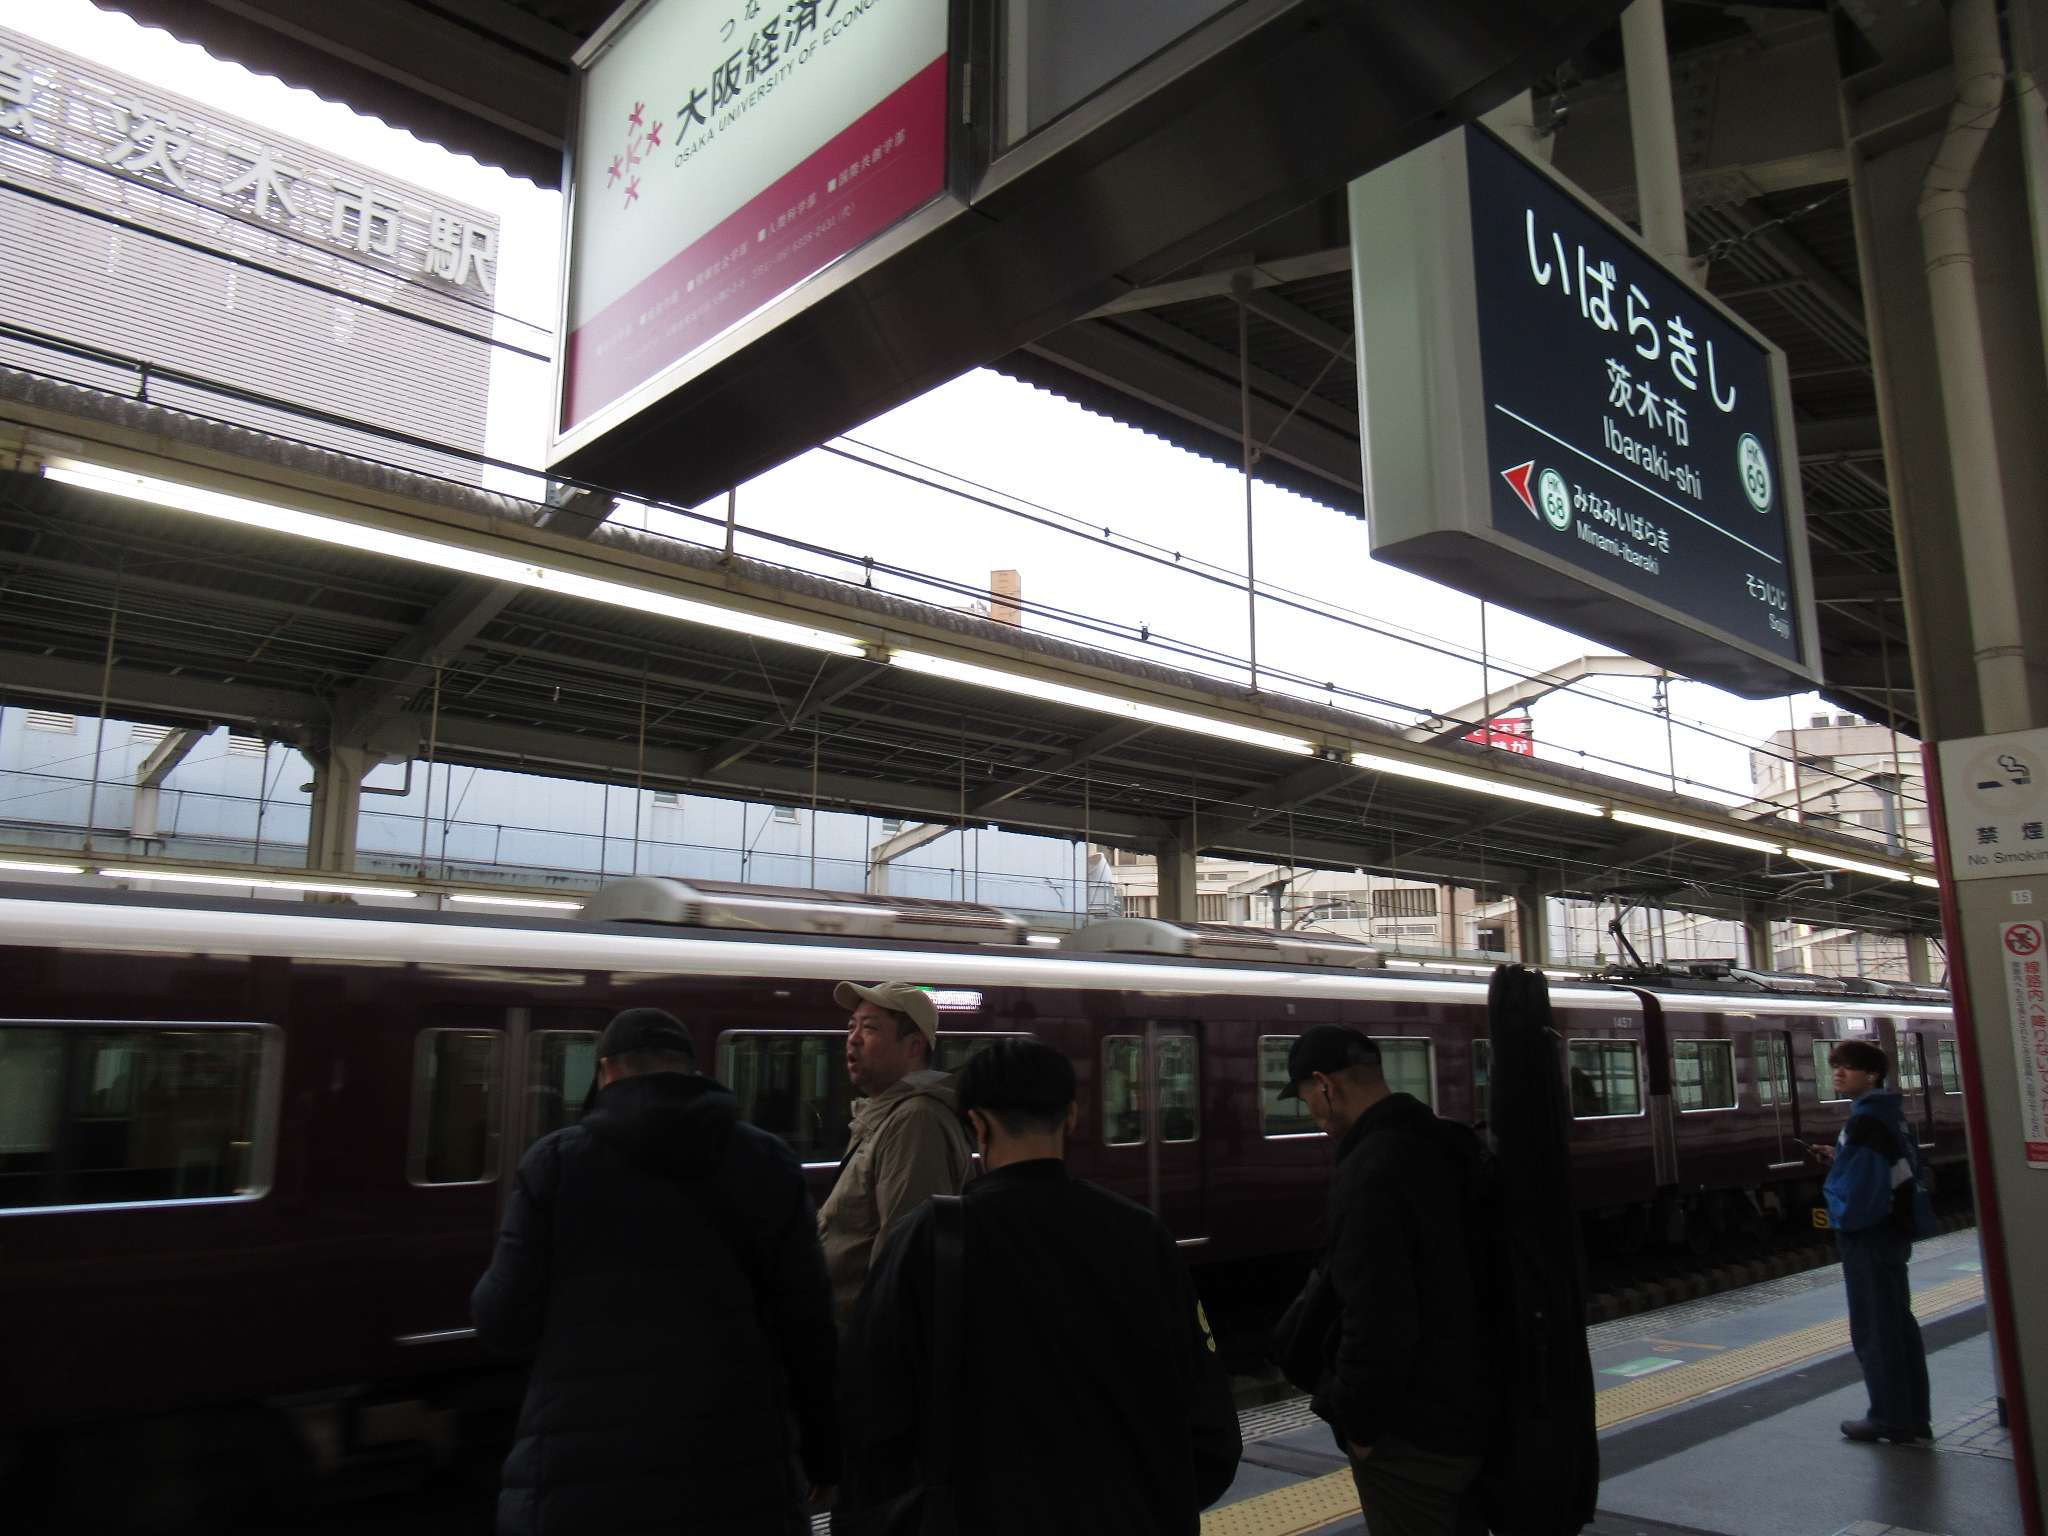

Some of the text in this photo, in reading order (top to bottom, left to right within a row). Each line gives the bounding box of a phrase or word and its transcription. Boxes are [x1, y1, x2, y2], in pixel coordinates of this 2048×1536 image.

[674, 0, 880, 168] OSAKA UNIVERSITY OF ECONO
[104, 98, 497, 295] 茨木市駅
[1526, 208, 1737, 413] いばらきし
[1604, 357, 1690, 447] 茨木市
[1602, 415, 1703, 501] Ibaraki-shi
[1746, 464, 1766, 499] 69
[1547, 493, 1566, 520] 68
[1576, 519, 1661, 576] Minami-ibaraki
[1745, 572, 1788, 612] そうじじ
[1967, 854, 1989, 866] No
